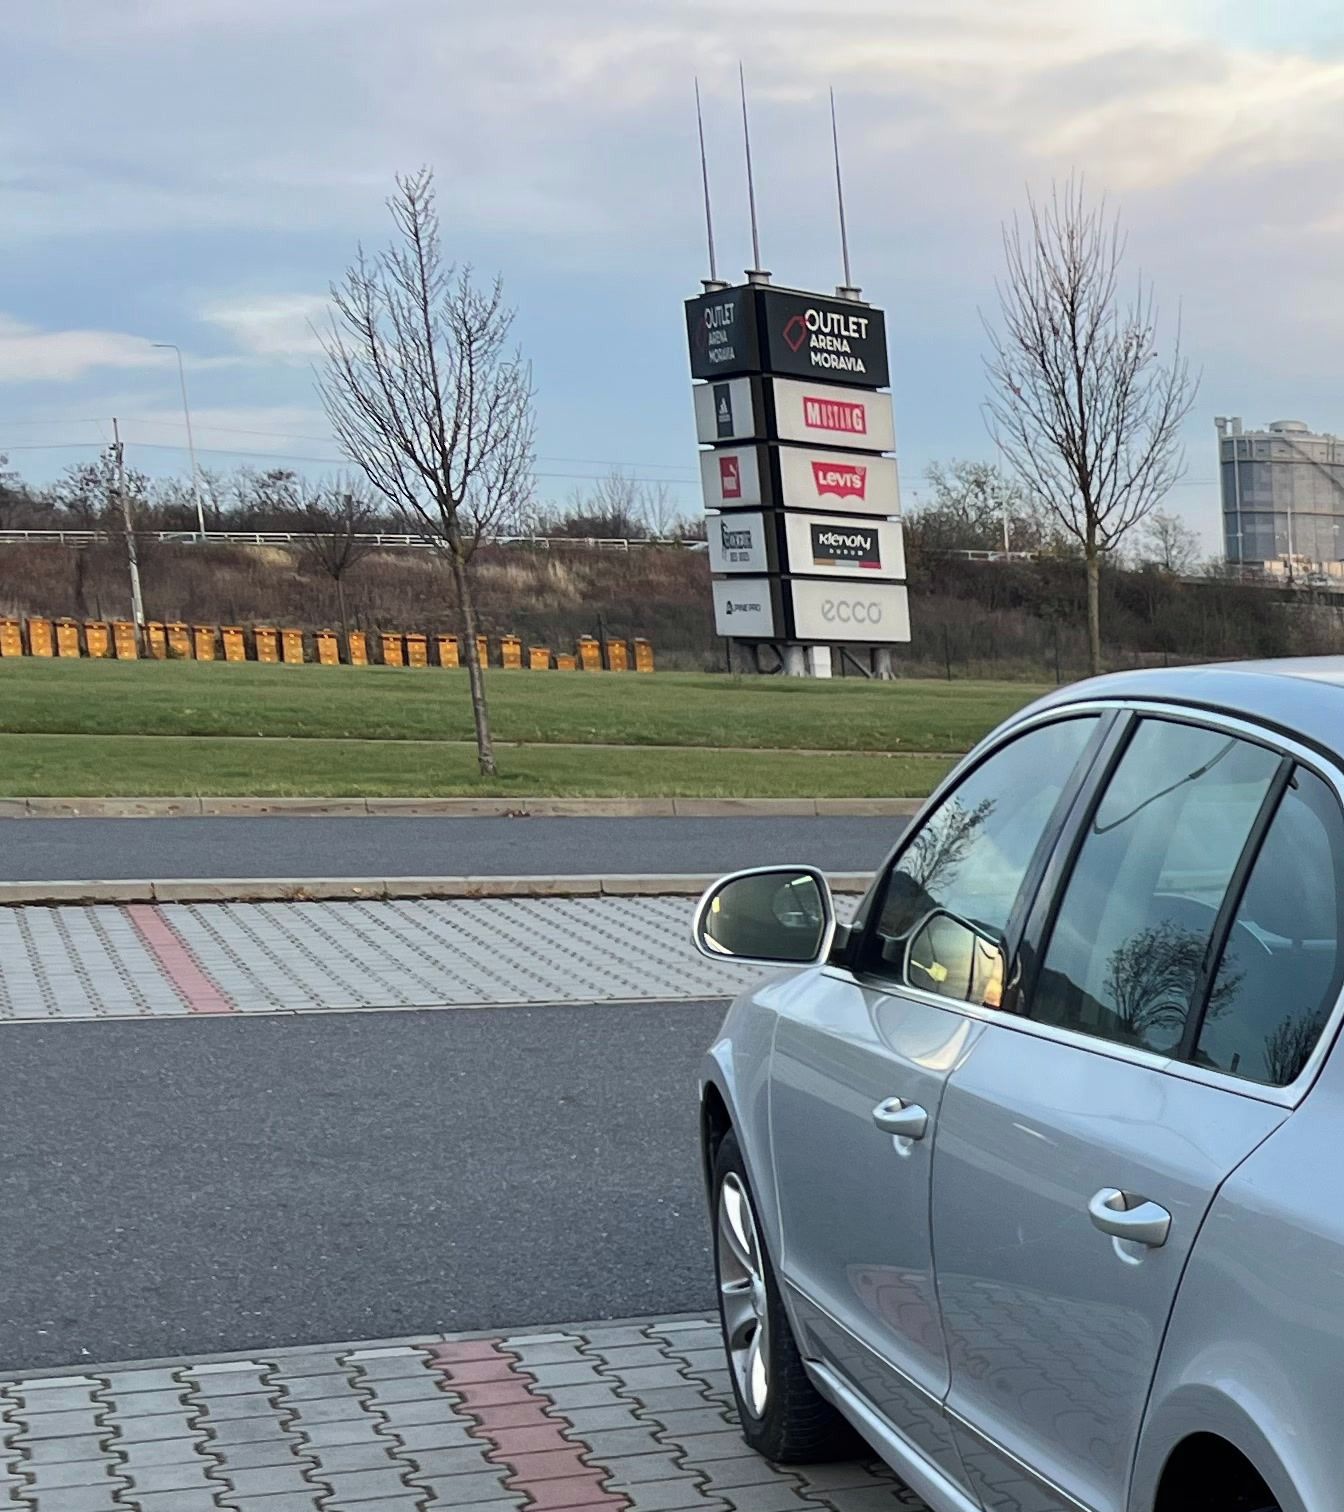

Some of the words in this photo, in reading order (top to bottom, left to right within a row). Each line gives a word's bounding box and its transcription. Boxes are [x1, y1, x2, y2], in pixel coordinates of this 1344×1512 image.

[704, 303, 735, 329] OUTLET
[805, 309, 869, 339] OUTLET
[809, 334, 851, 353] ARENA
[810, 352, 866, 374] MORAVIA
[806, 402, 864, 432] MUSTANG
[821, 599, 882, 625] ecco
